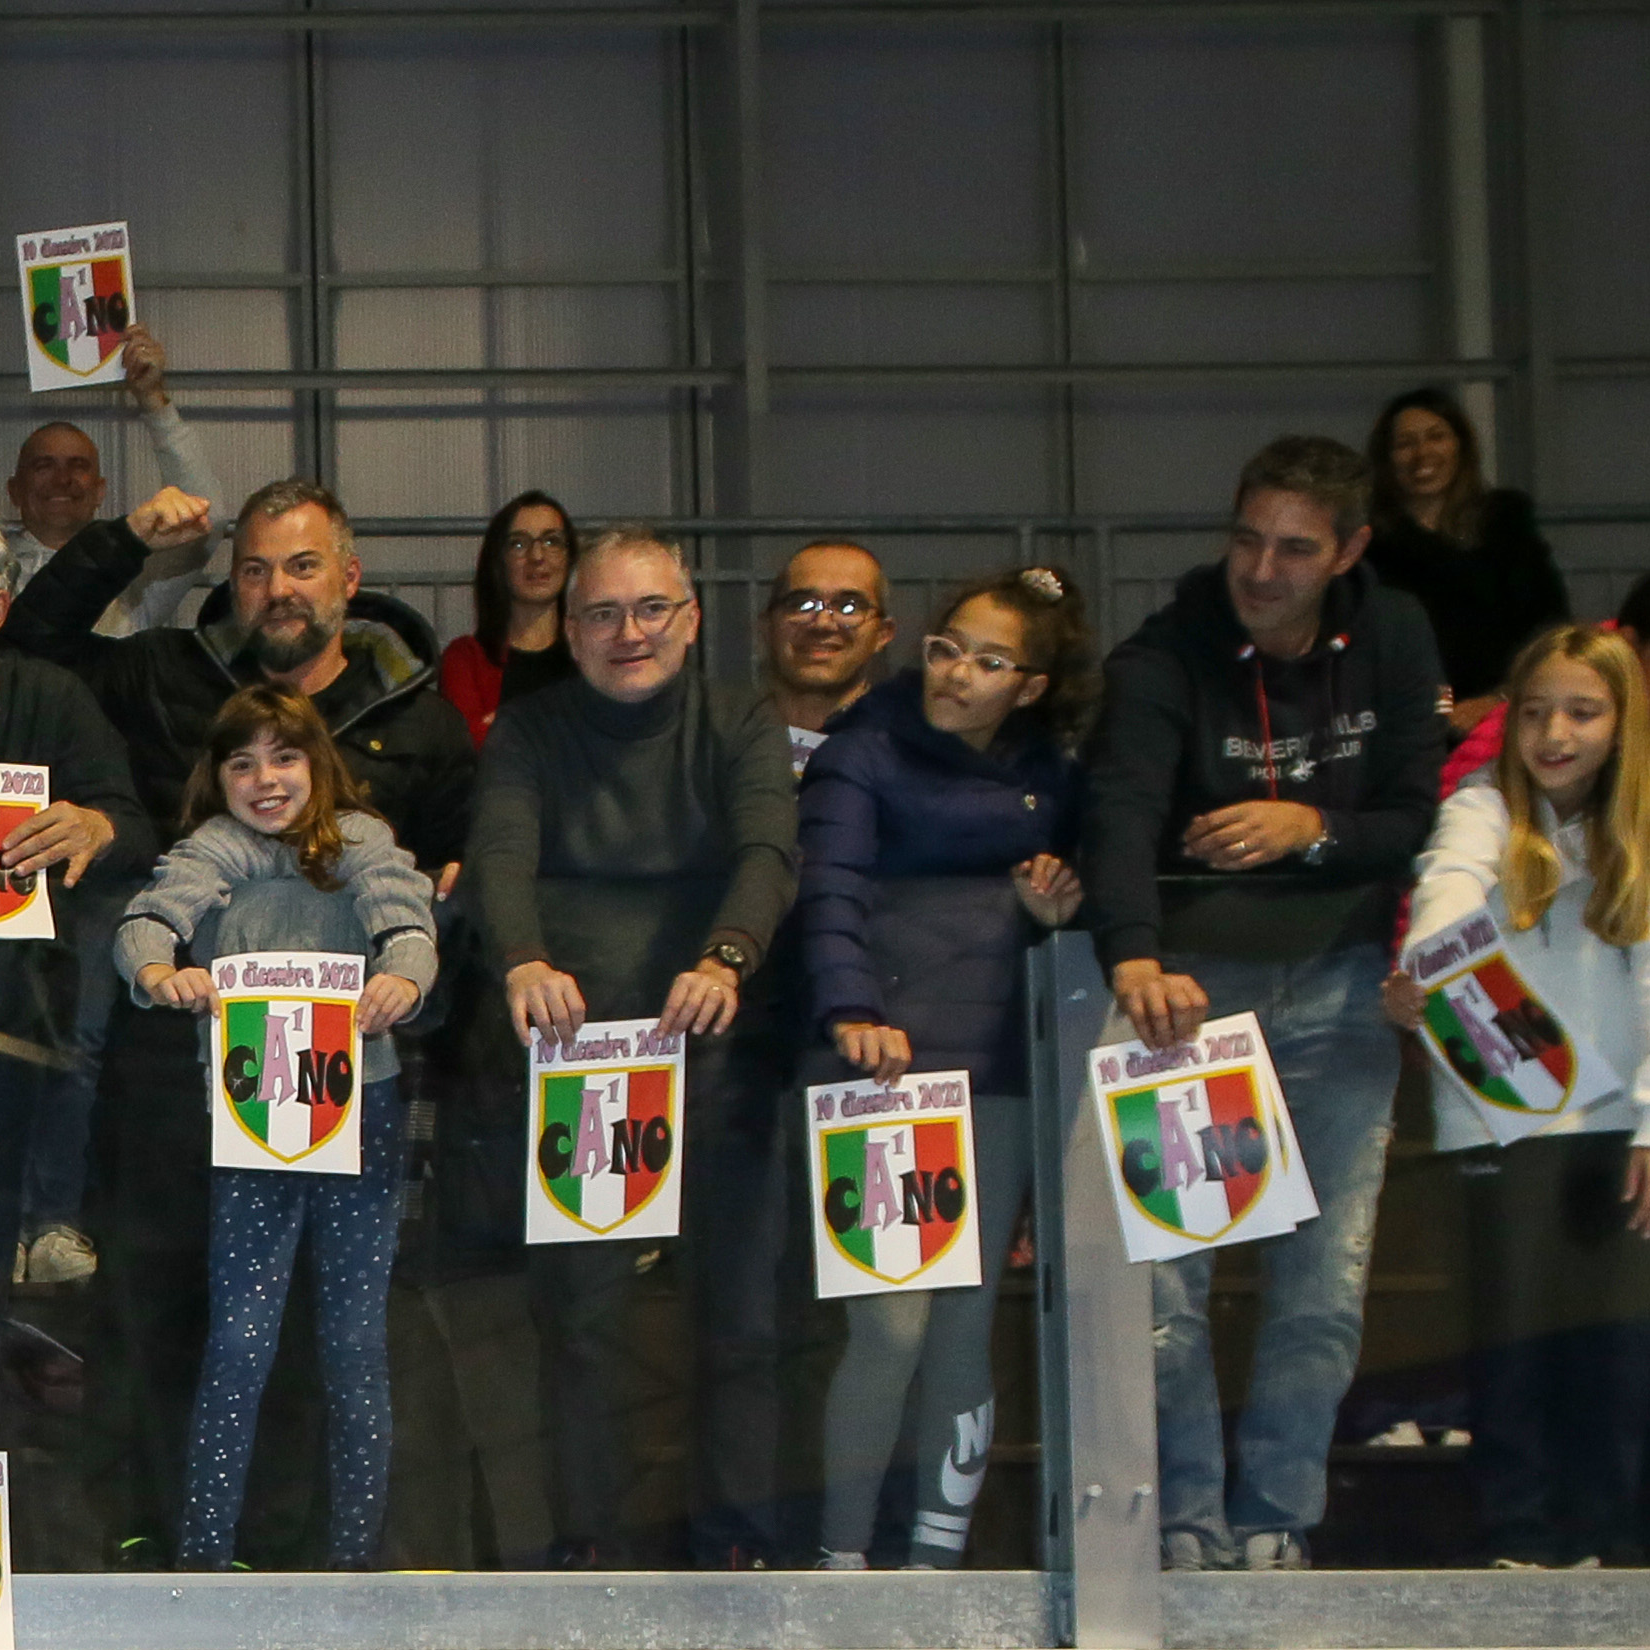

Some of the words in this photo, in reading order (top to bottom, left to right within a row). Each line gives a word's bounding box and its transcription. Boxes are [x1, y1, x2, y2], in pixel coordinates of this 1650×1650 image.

[1, 770, 45, 795] 2022
[217, 962, 237, 987] 10
[243, 961, 313, 986] dicembre
[318, 962, 361, 987] 2022
[814, 1092, 834, 1119] 10
[840, 1086, 913, 1116] dicembre
[917, 1079, 964, 1109] 2022
